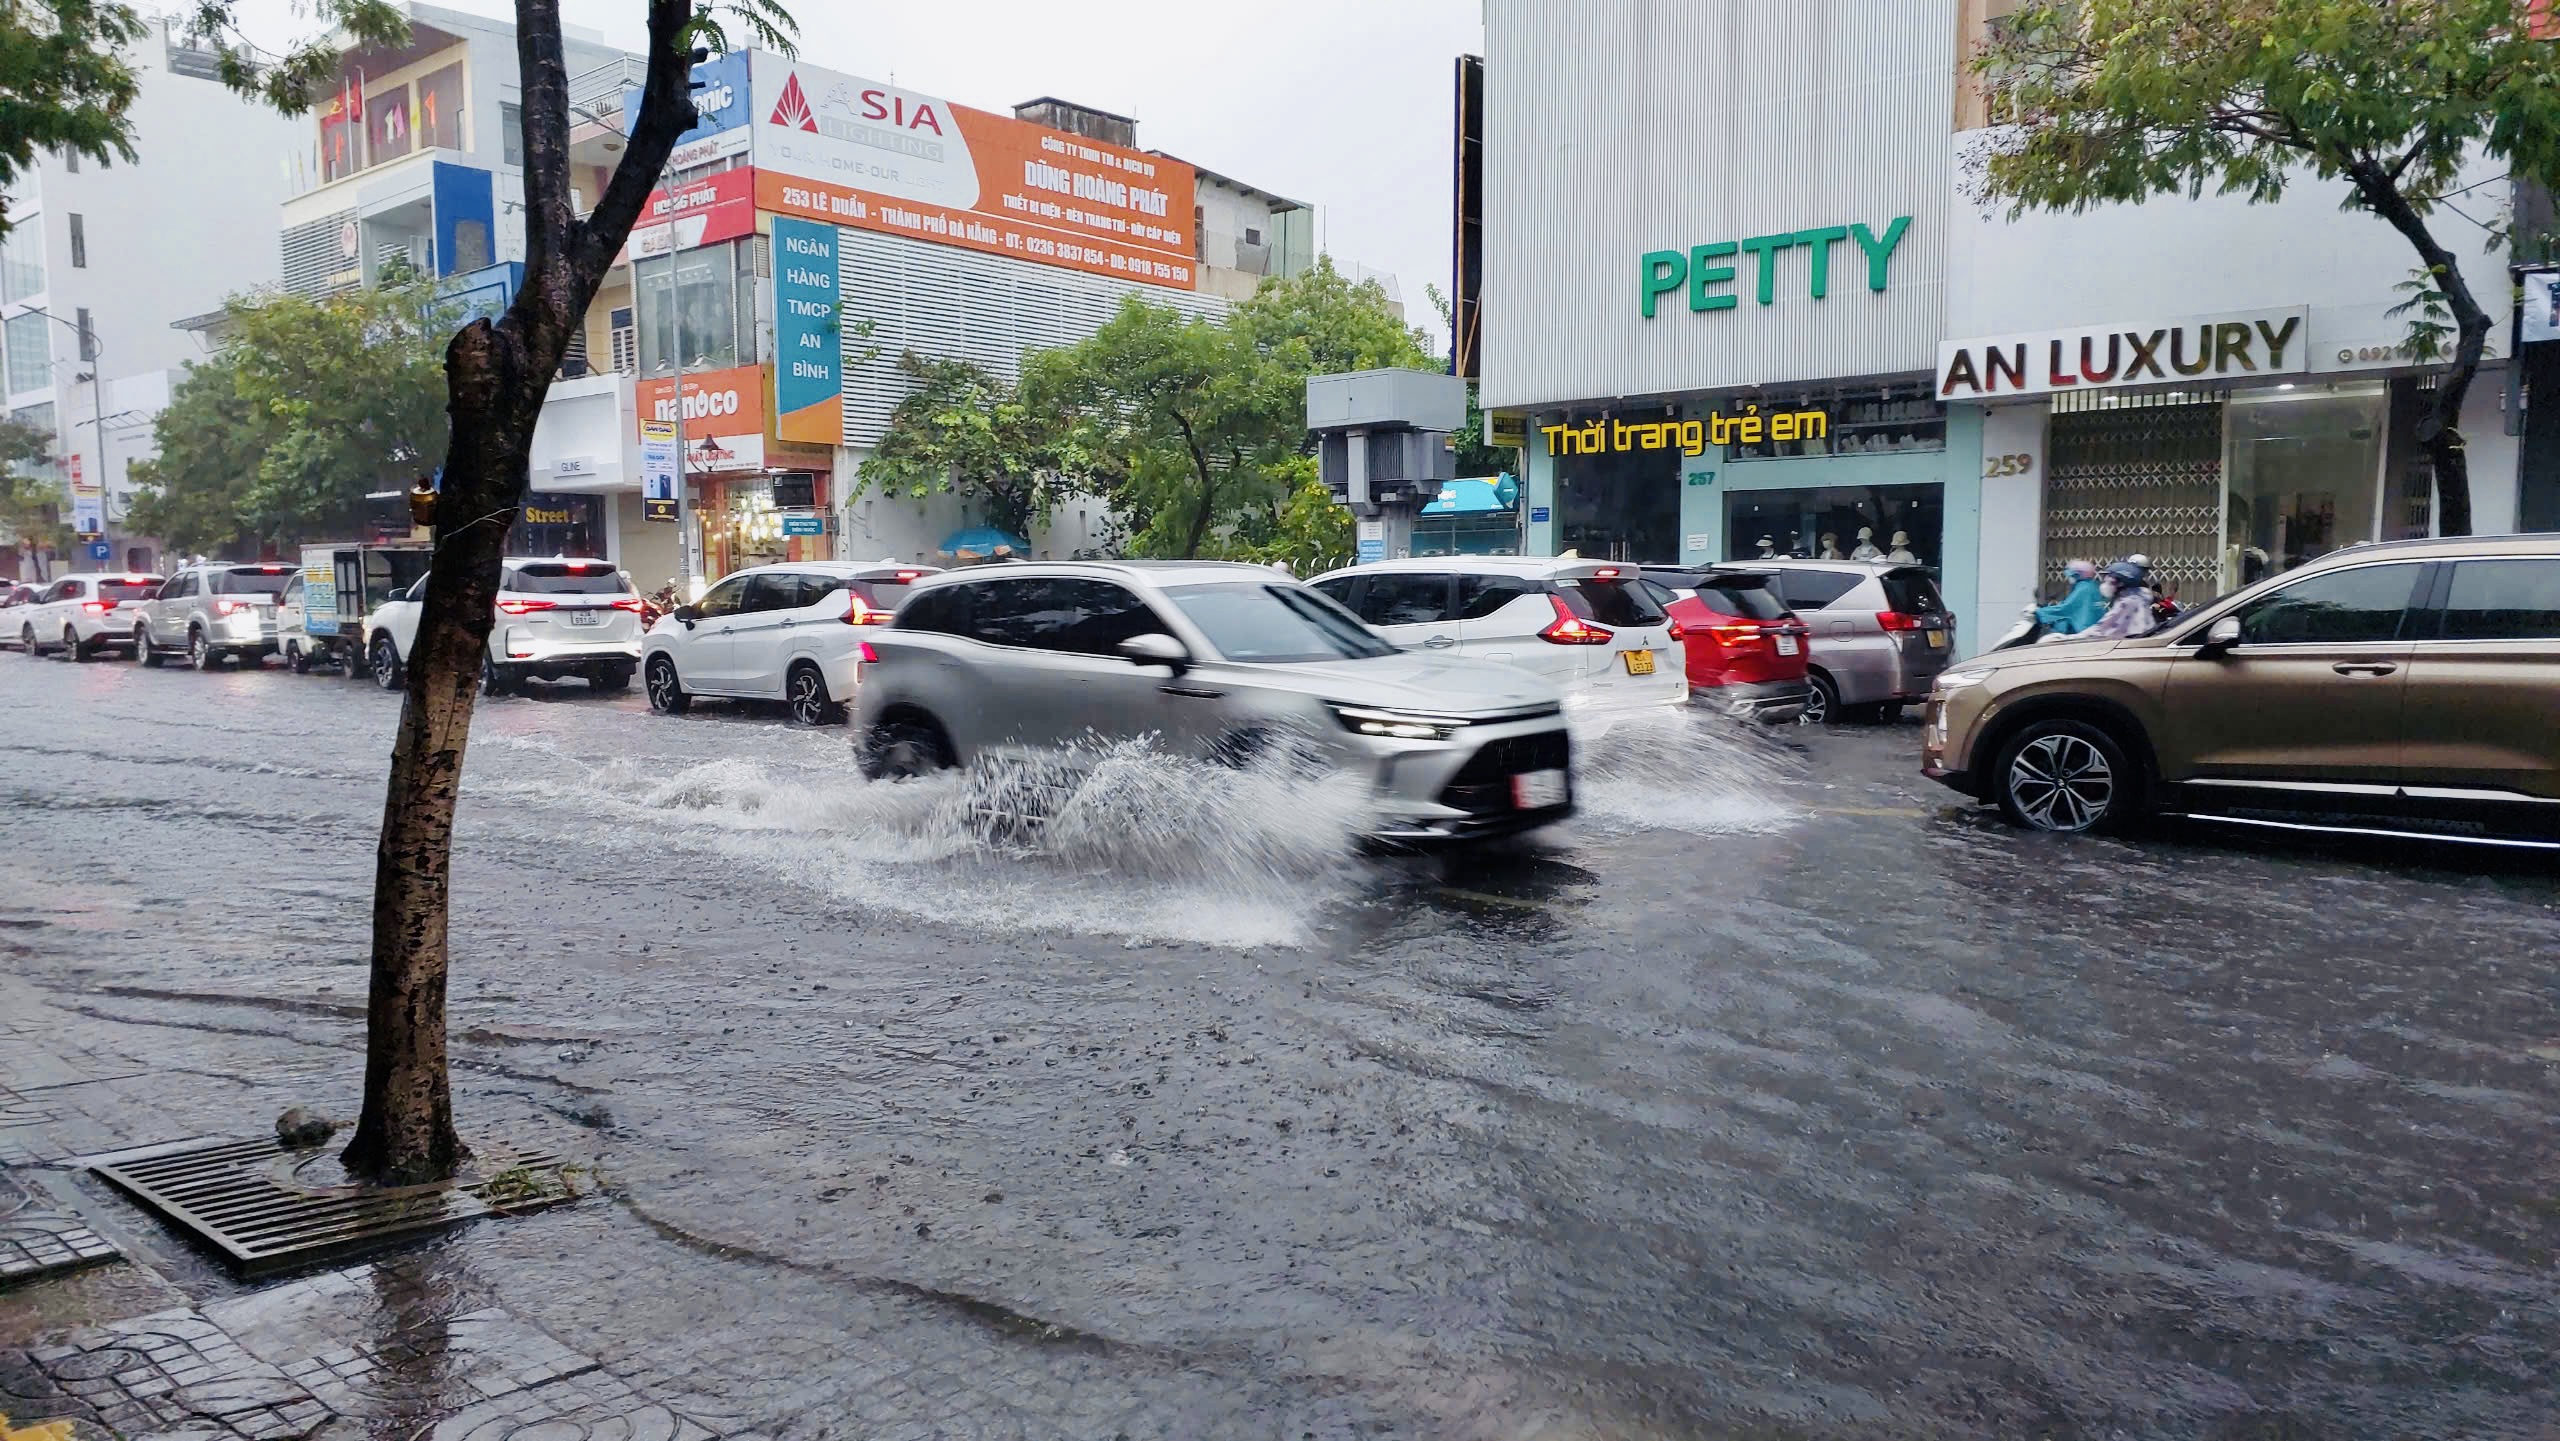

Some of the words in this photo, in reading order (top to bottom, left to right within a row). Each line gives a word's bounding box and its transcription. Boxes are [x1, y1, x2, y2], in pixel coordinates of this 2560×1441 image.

[820, 80, 943, 136] ASIA
[827, 118, 939, 159] LIGHTING
[1041, 136, 1064, 153] CÔNG
[1066, 142, 1077, 157] TY
[1115, 158, 1122, 169] &
[1123, 157, 1142, 174] DỊCH
[1143, 163, 1155, 179] VỤ
[653, 193, 688, 215] HONG
[689, 184, 718, 206] PHÁT
[1024, 158, 1070, 195] DŨNG
[1073, 173, 1127, 209] HOÀNG
[1129, 187, 1168, 217] PHÁT
[1003, 192, 1028, 211] THIẾT
[1030, 198, 1040, 215] BỊ
[1085, 212, 1112, 231] TRANG
[1146, 226, 1162, 241] CÁP
[783, 186, 809, 208] 253
[812, 191, 828, 211] LÊ
[832, 194, 866, 219] DUẨN
[880, 207, 921, 230] THÀNH
[923, 212, 946, 235] PHỐ
[949, 217, 965, 238] ĐÀ
[967, 220, 997, 245] NẴNG
[1005, 232, 1023, 250] ĐT:
[1026, 236, 1055, 256] 0236
[1057, 243, 1082, 261] 3837
[1084, 248, 1104, 266] 854
[1128, 257, 1152, 275] 0918
[1153, 262, 1171, 279] 755
[1172, 265, 1189, 282] 150
[785, 237, 830, 258] NGÂN
[786, 267, 831, 289] HÀNG
[1642, 215, 1912, 318] PETTY
[786, 298, 831, 319] TMCP
[799, 332, 821, 349] AN
[1941, 342, 2027, 397] AN
[2049, 316, 2301, 388] LUXURY
[792, 360, 829, 380] BÌNH
[654, 389, 739, 422] nanoco
[1541, 419, 1606, 456] Thời
[1613, 418, 1703, 457] trang
[1711, 404, 1763, 445] trẻ
[1771, 410, 1828, 441] em
[1687, 471, 1716, 486] 257
[1985, 453, 2032, 479] 259
[526, 506, 570, 524] Street
